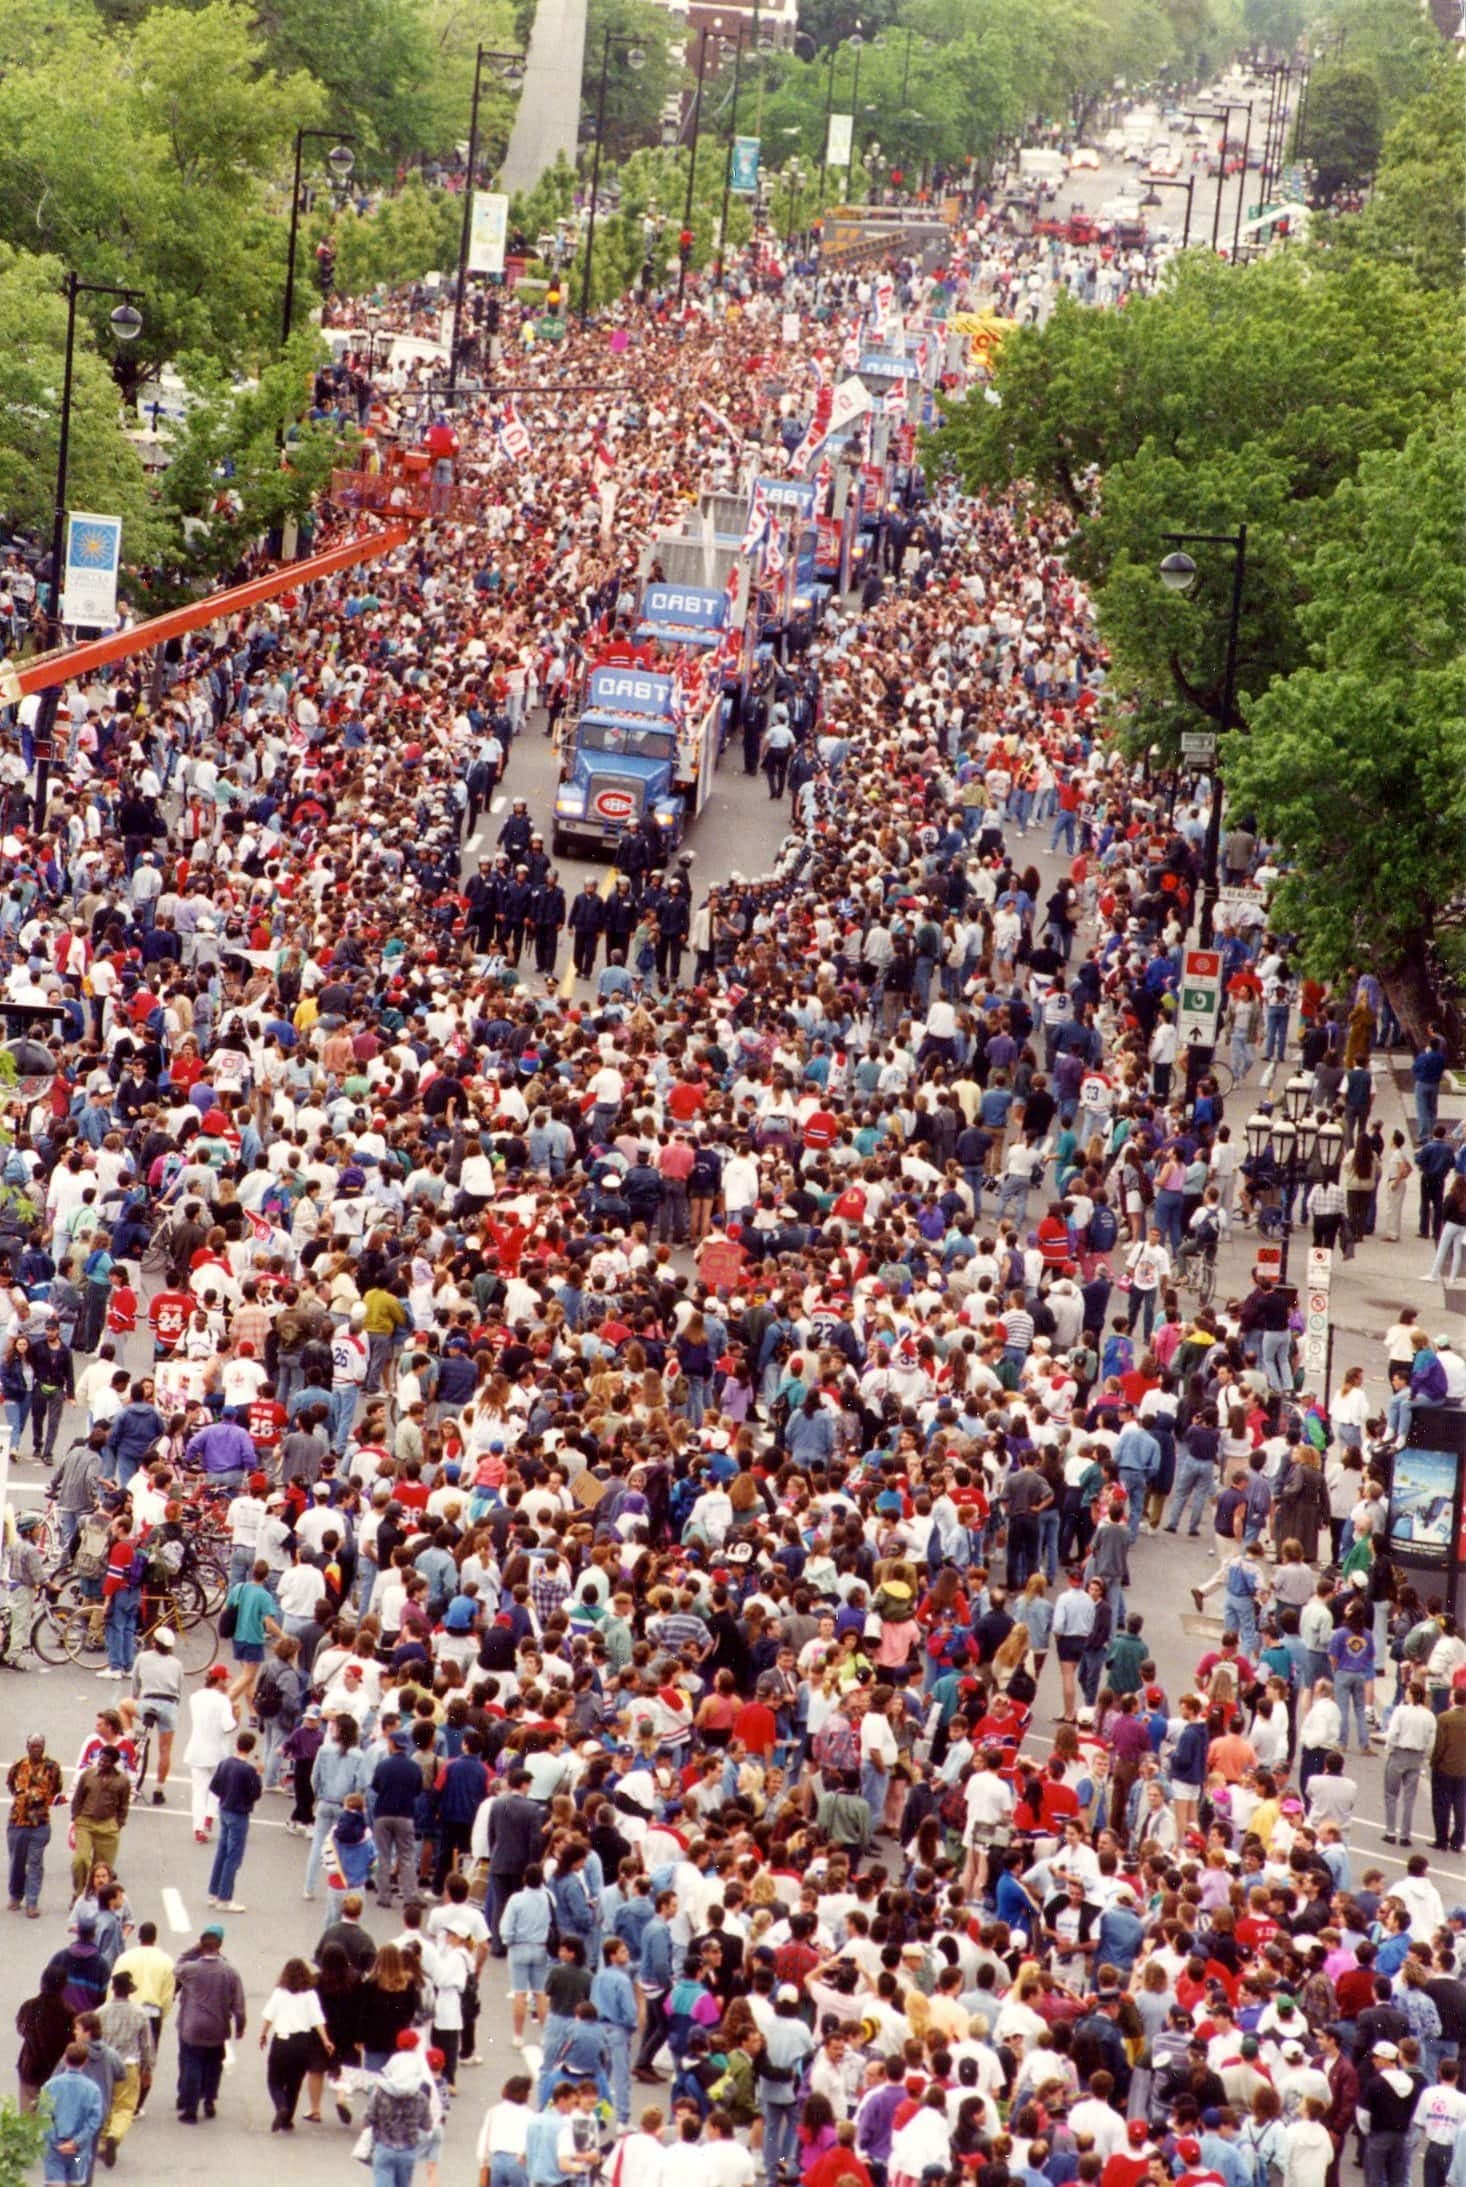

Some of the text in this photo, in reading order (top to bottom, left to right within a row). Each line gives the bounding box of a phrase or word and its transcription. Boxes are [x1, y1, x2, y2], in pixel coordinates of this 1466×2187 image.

[158, 1311, 182, 1332] 24
[334, 1346, 350, 1368] 26
[250, 1417, 274, 1438] 26
